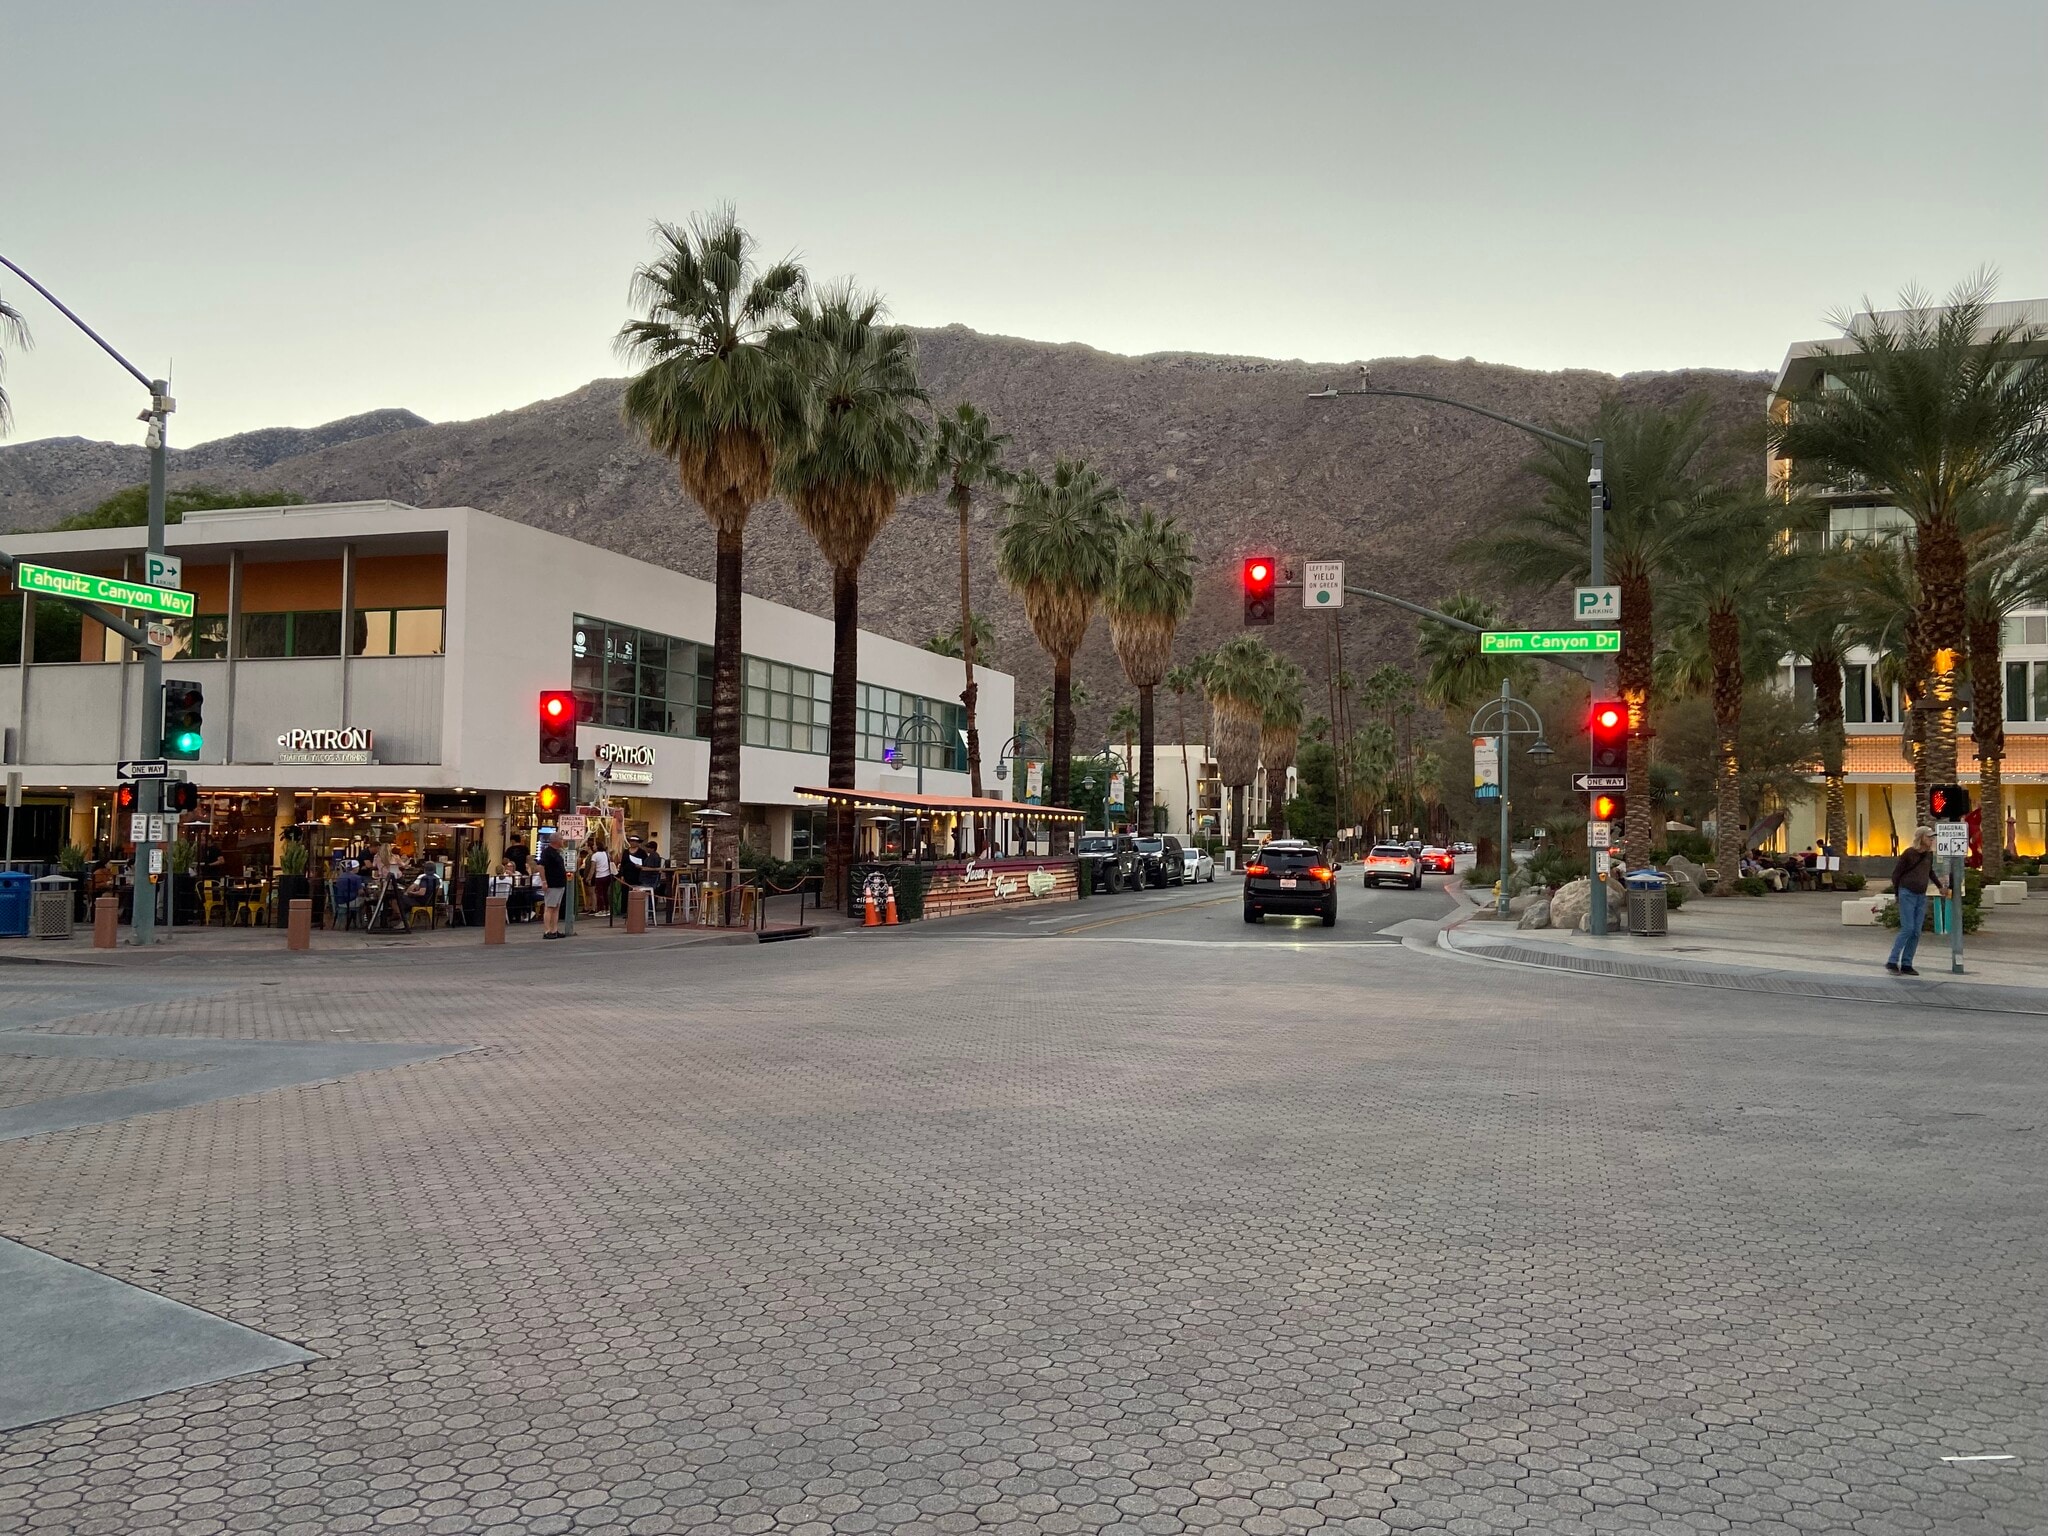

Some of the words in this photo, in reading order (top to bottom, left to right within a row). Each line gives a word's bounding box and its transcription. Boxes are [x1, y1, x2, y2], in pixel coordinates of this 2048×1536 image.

[23, 567, 90, 593] Tahquitz
[98, 582, 153, 604] Canyon
[160, 592, 190, 613] Way
[1485, 636, 1523, 648] Palm
[1530, 635, 1588, 650] Canyon
[1596, 635, 1616, 647] Dr
[131, 766, 146, 774] ONE
[148, 765, 163, 773] WAY
[1938, 843, 1949, 851] OK
